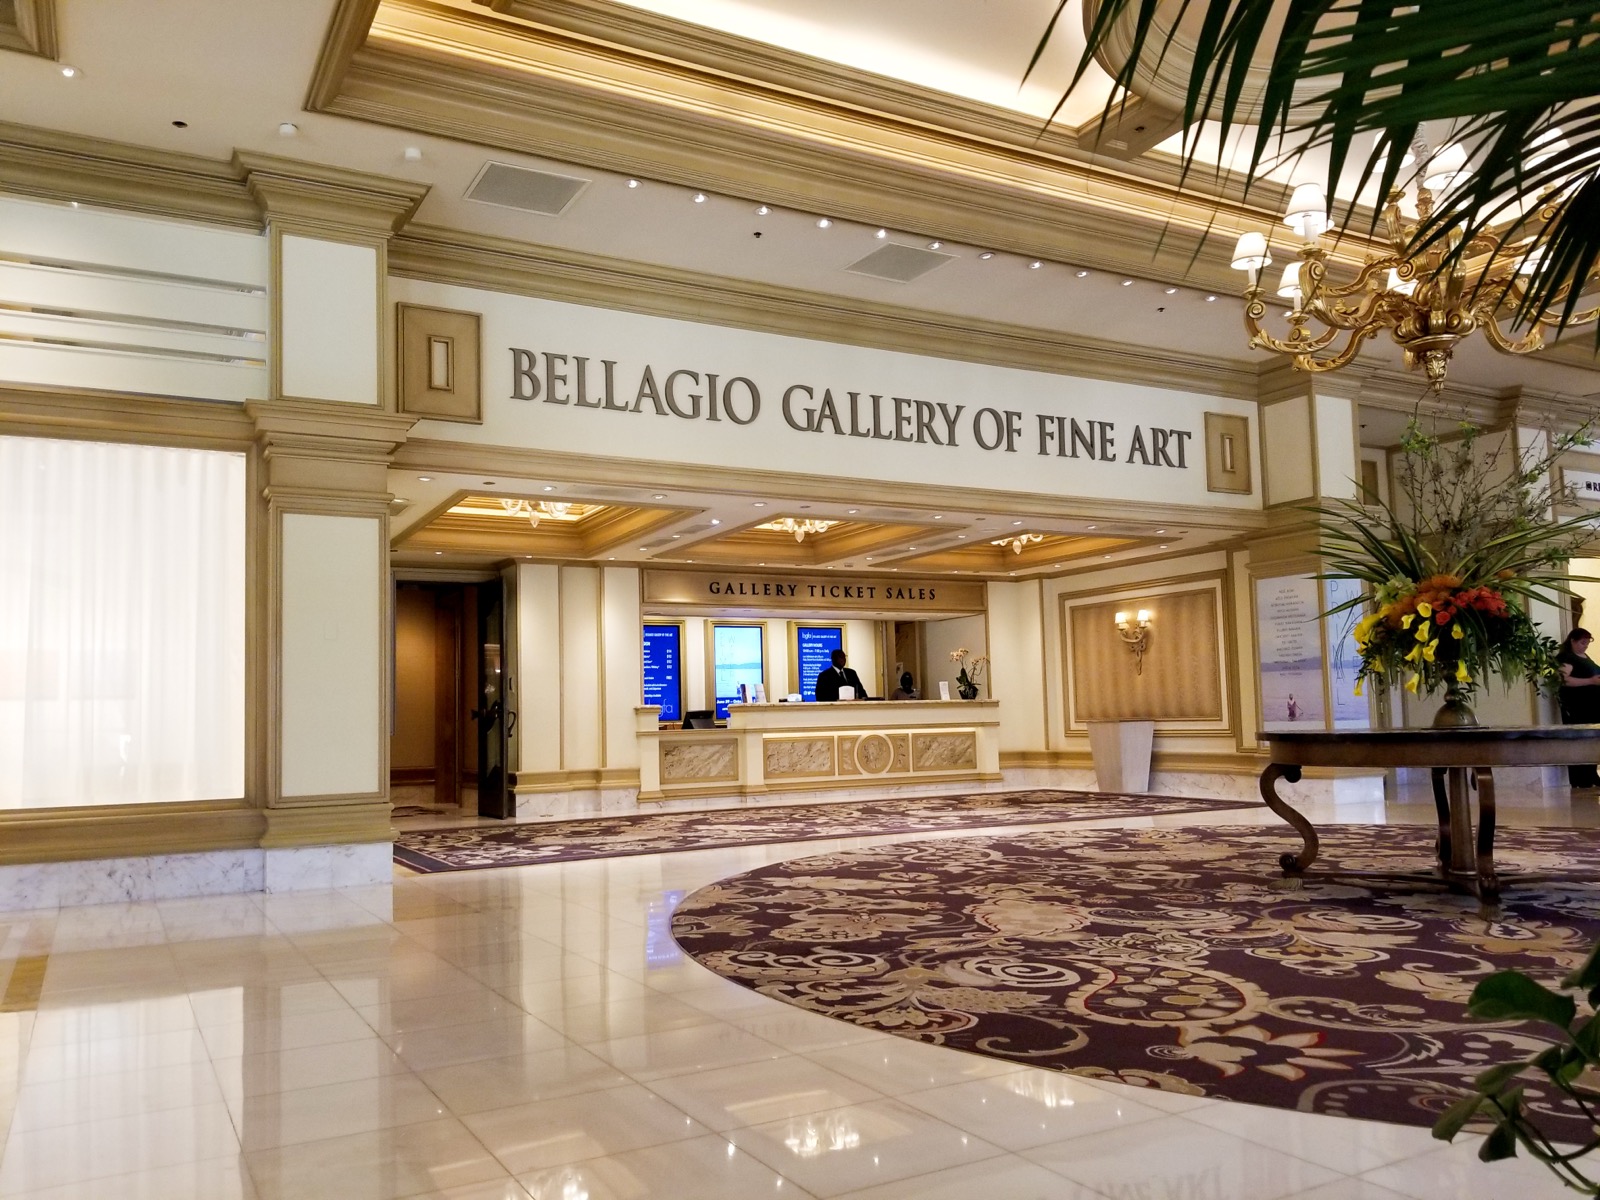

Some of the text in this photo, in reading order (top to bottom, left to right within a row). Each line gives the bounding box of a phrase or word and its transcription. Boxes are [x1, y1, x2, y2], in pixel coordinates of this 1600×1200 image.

[508, 347, 1192, 469] BELLAGIO GALLERY OF FINE ART
[709, 581, 936, 600] GALLERY TICKET SALES
